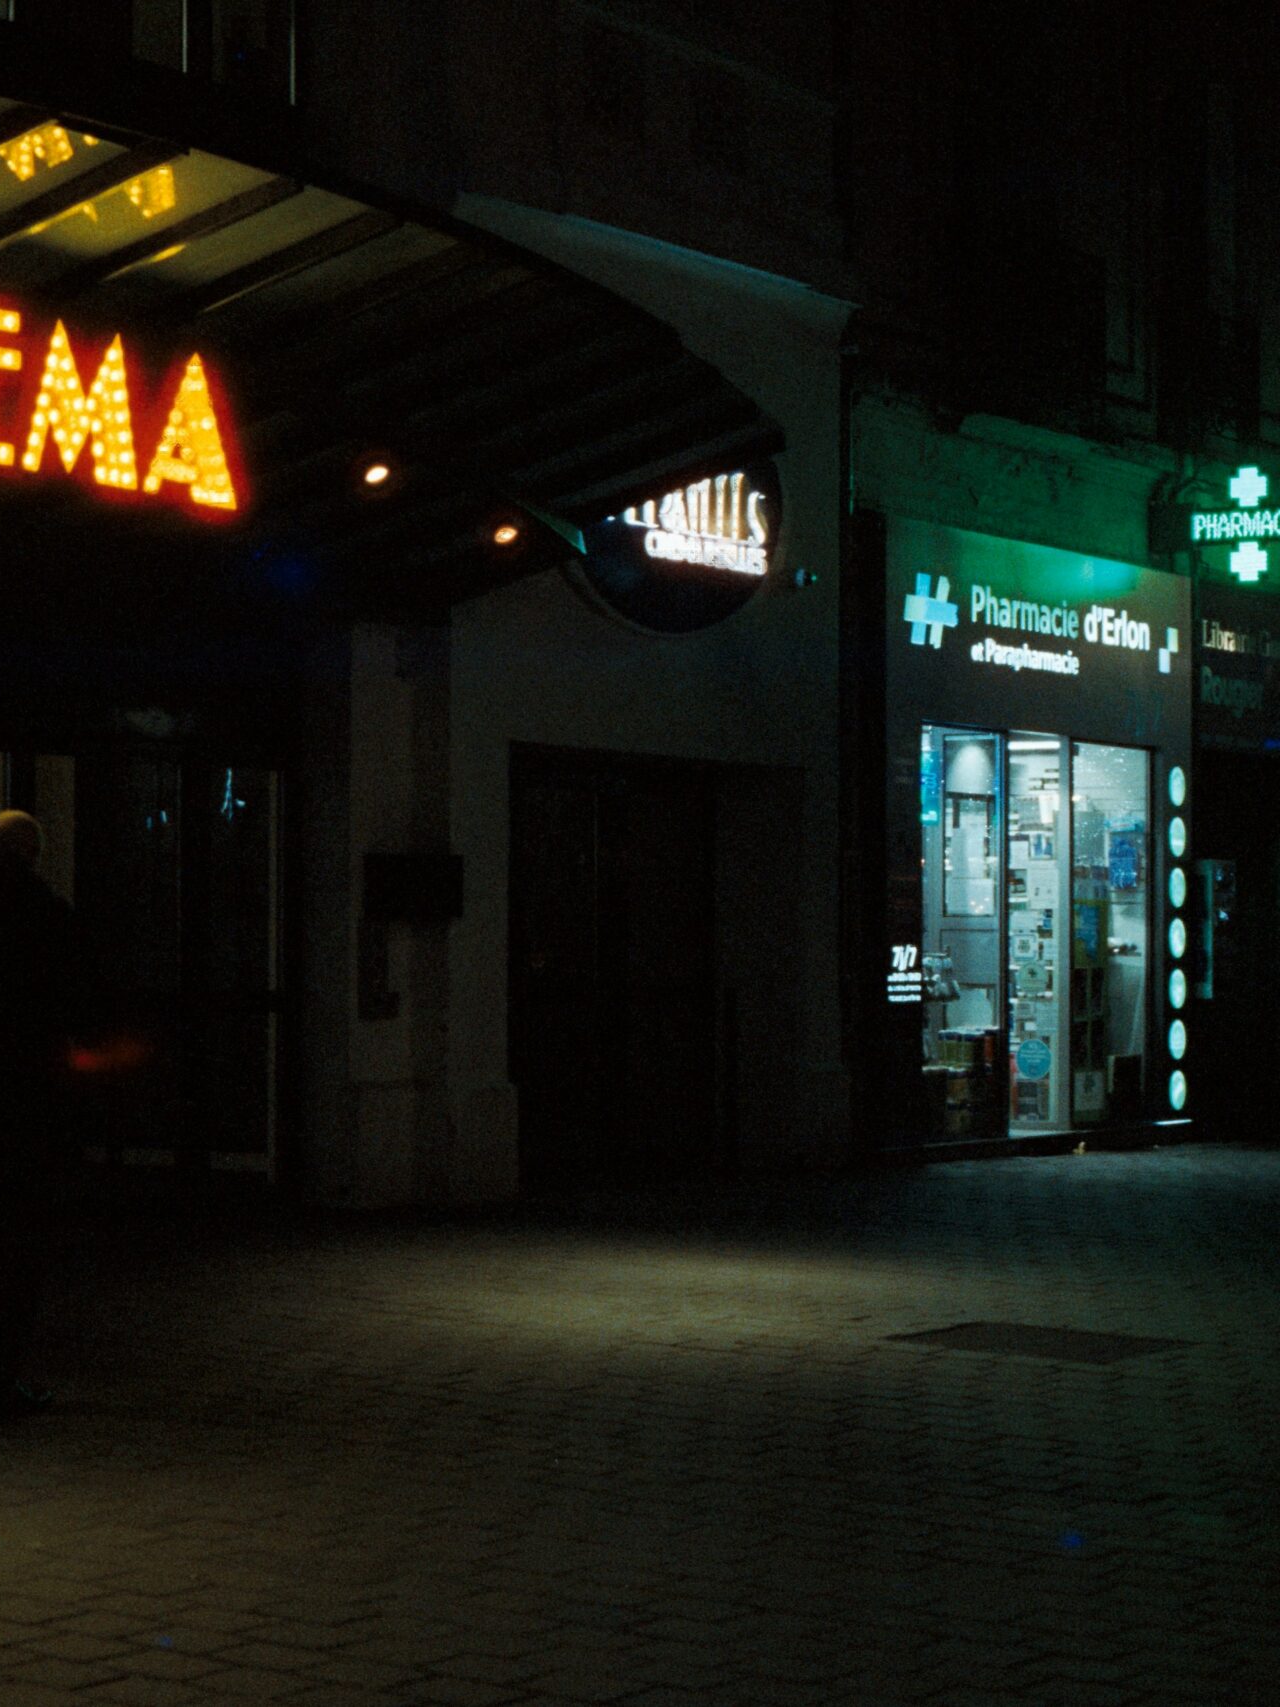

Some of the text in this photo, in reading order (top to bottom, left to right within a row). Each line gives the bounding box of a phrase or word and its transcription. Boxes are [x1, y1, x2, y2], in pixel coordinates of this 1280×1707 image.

[971, 585, 1151, 651] Pharmacie d'Erlon
[971, 638, 1080, 675] et Parapharmacie
